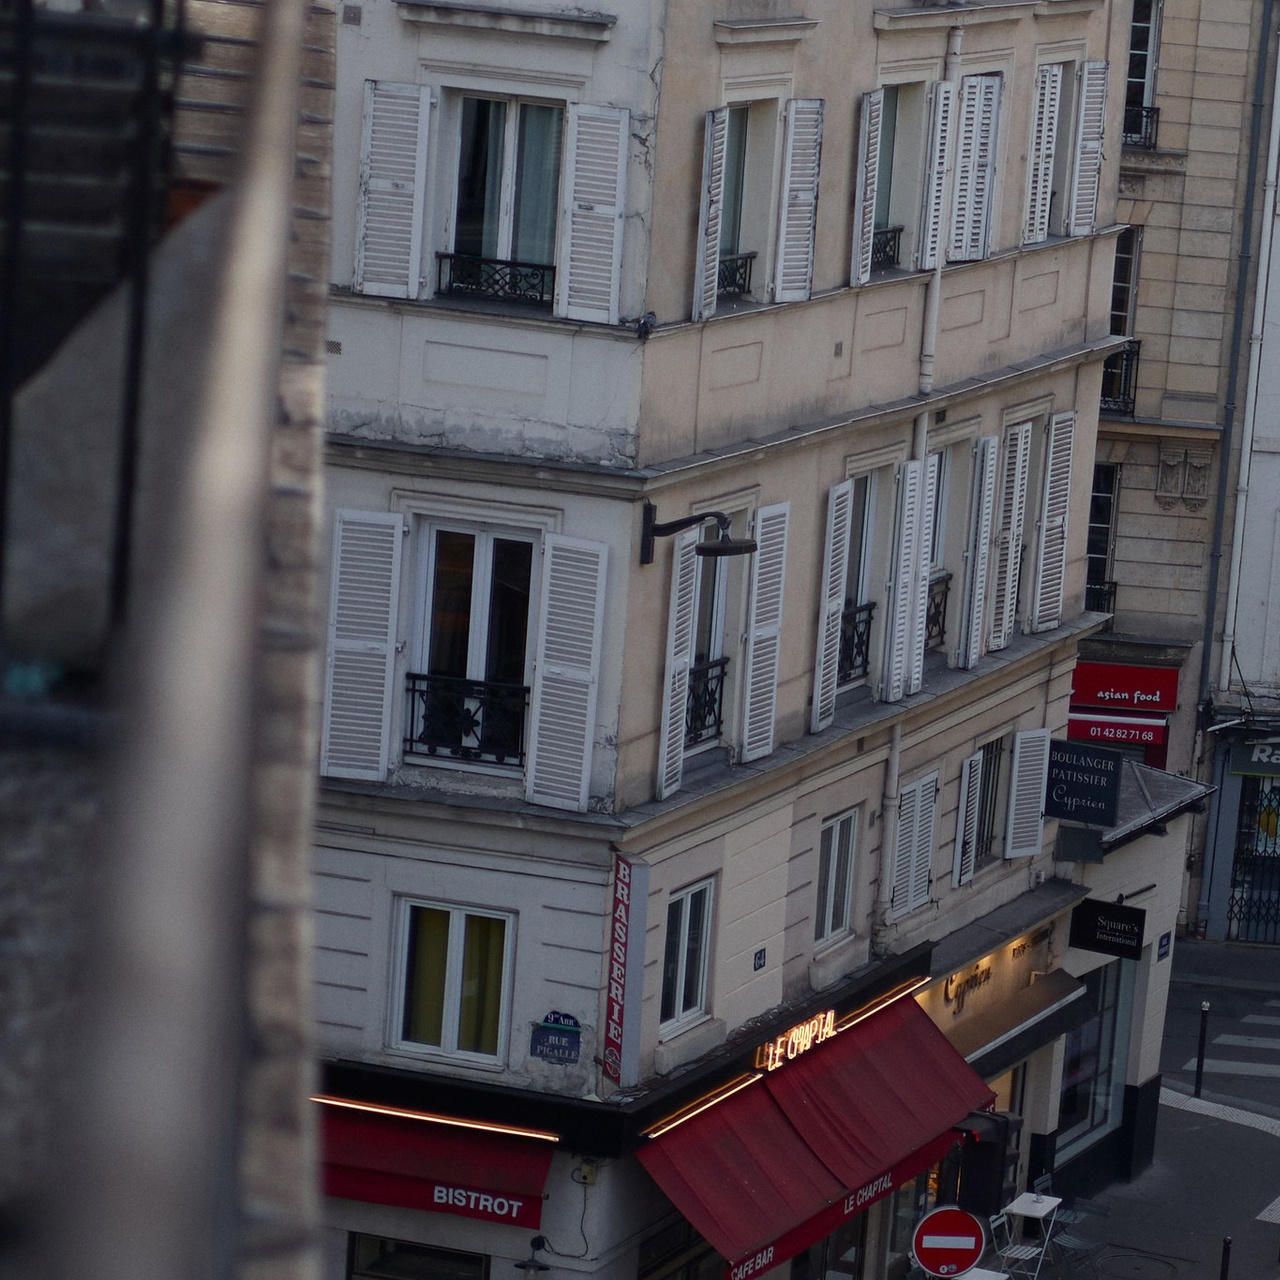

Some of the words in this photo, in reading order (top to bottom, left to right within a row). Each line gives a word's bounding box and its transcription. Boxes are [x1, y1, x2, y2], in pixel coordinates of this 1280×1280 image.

[1097, 688, 1129, 700] asian
[1134, 690, 1160, 704] food
[1090, 727, 1100, 736] 01
[1103, 728, 1114, 738] 42
[1116, 729, 1128, 738] 82
[1130, 730, 1139, 740] 71
[1142, 732, 1154, 740] 68
[1052, 751, 1114, 772] BOULANGER
[1052, 768, 1107, 787] PATISSIER
[1052, 784, 1106, 812] Cyprien
[1096, 932, 1137, 947] International
[608, 861, 630, 1045] BRASSERIE
[756, 950, 764, 968] 64
[548, 1035, 568, 1046] RUE
[536, 1045, 578, 1060] PIGALLE
[434, 1185, 522, 1218] BISTROT
[844, 1195, 854, 1214] LE
[856, 1173, 892, 1206] CHAPTAL
[754, 1246, 774, 1270] BAR
